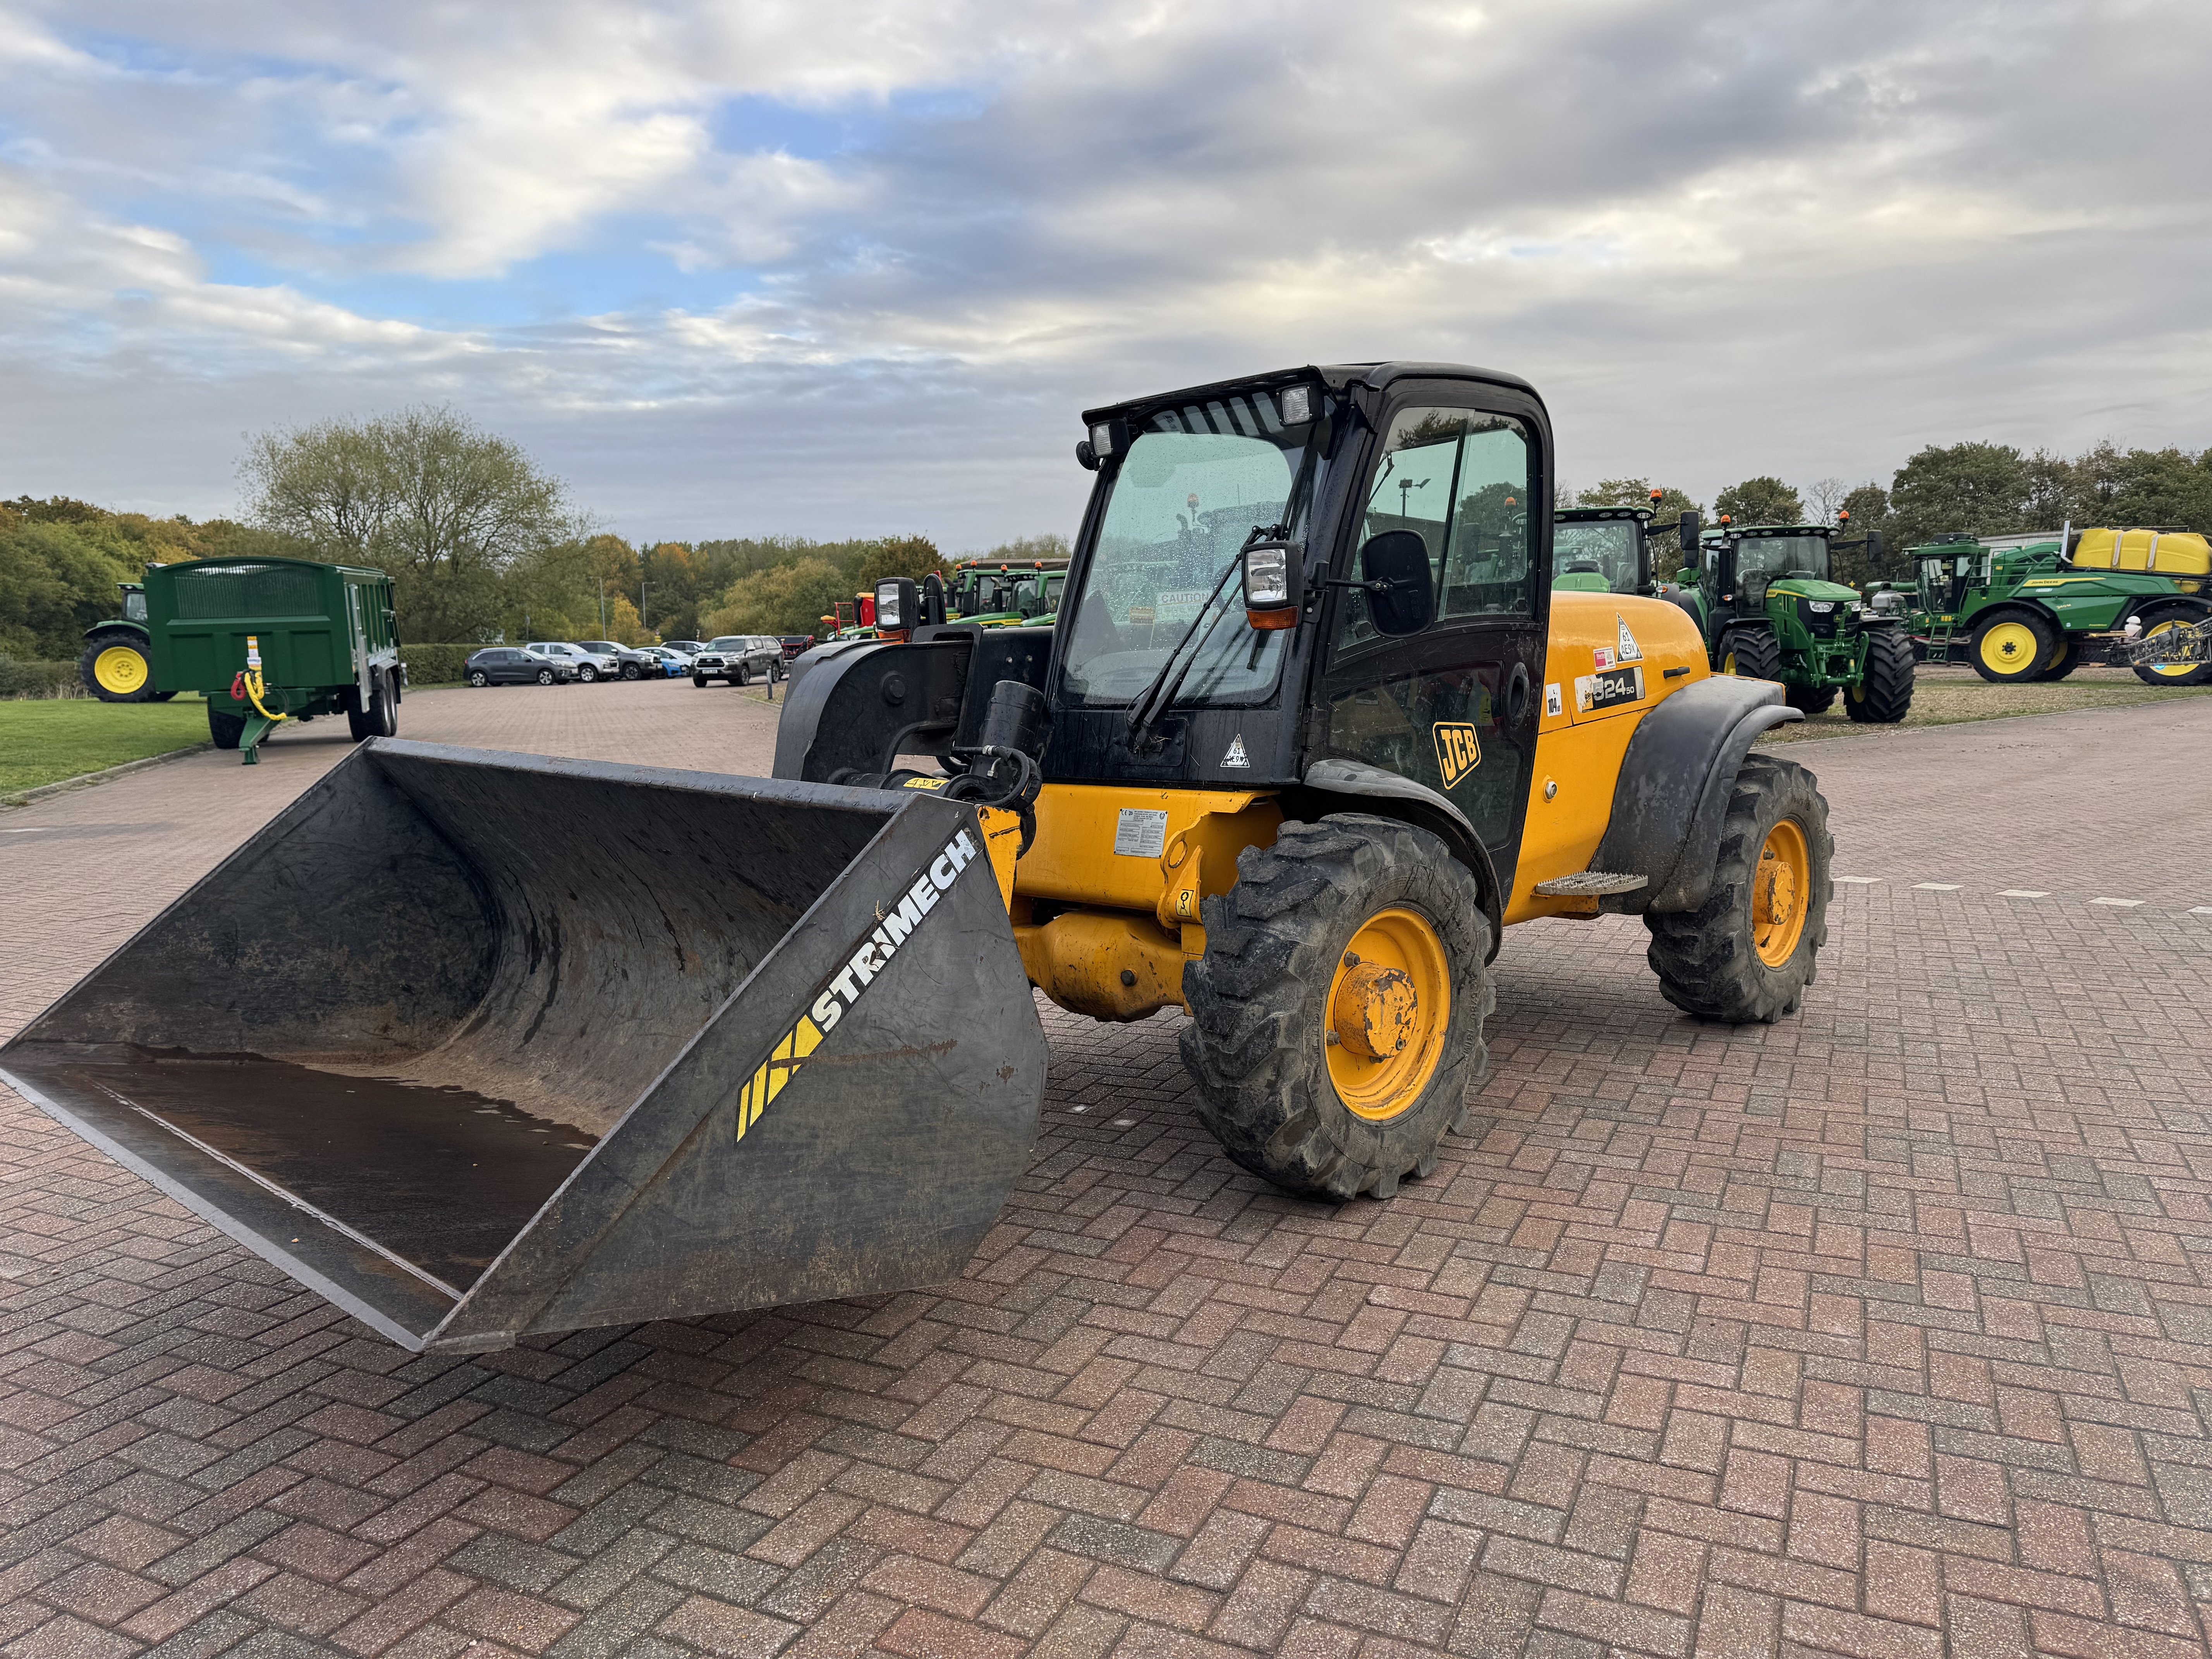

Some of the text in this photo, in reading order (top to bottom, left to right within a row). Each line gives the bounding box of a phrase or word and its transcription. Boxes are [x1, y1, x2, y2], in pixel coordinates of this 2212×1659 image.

[1161, 592, 1209, 603] CAUTION
[1622, 632, 1630, 642] 61
[1621, 643, 1635, 655] AE9X
[1548, 697, 1557, 714] 104
[1440, 729, 1477, 781] JCB
[811, 829, 977, 1032] STRIMECH
